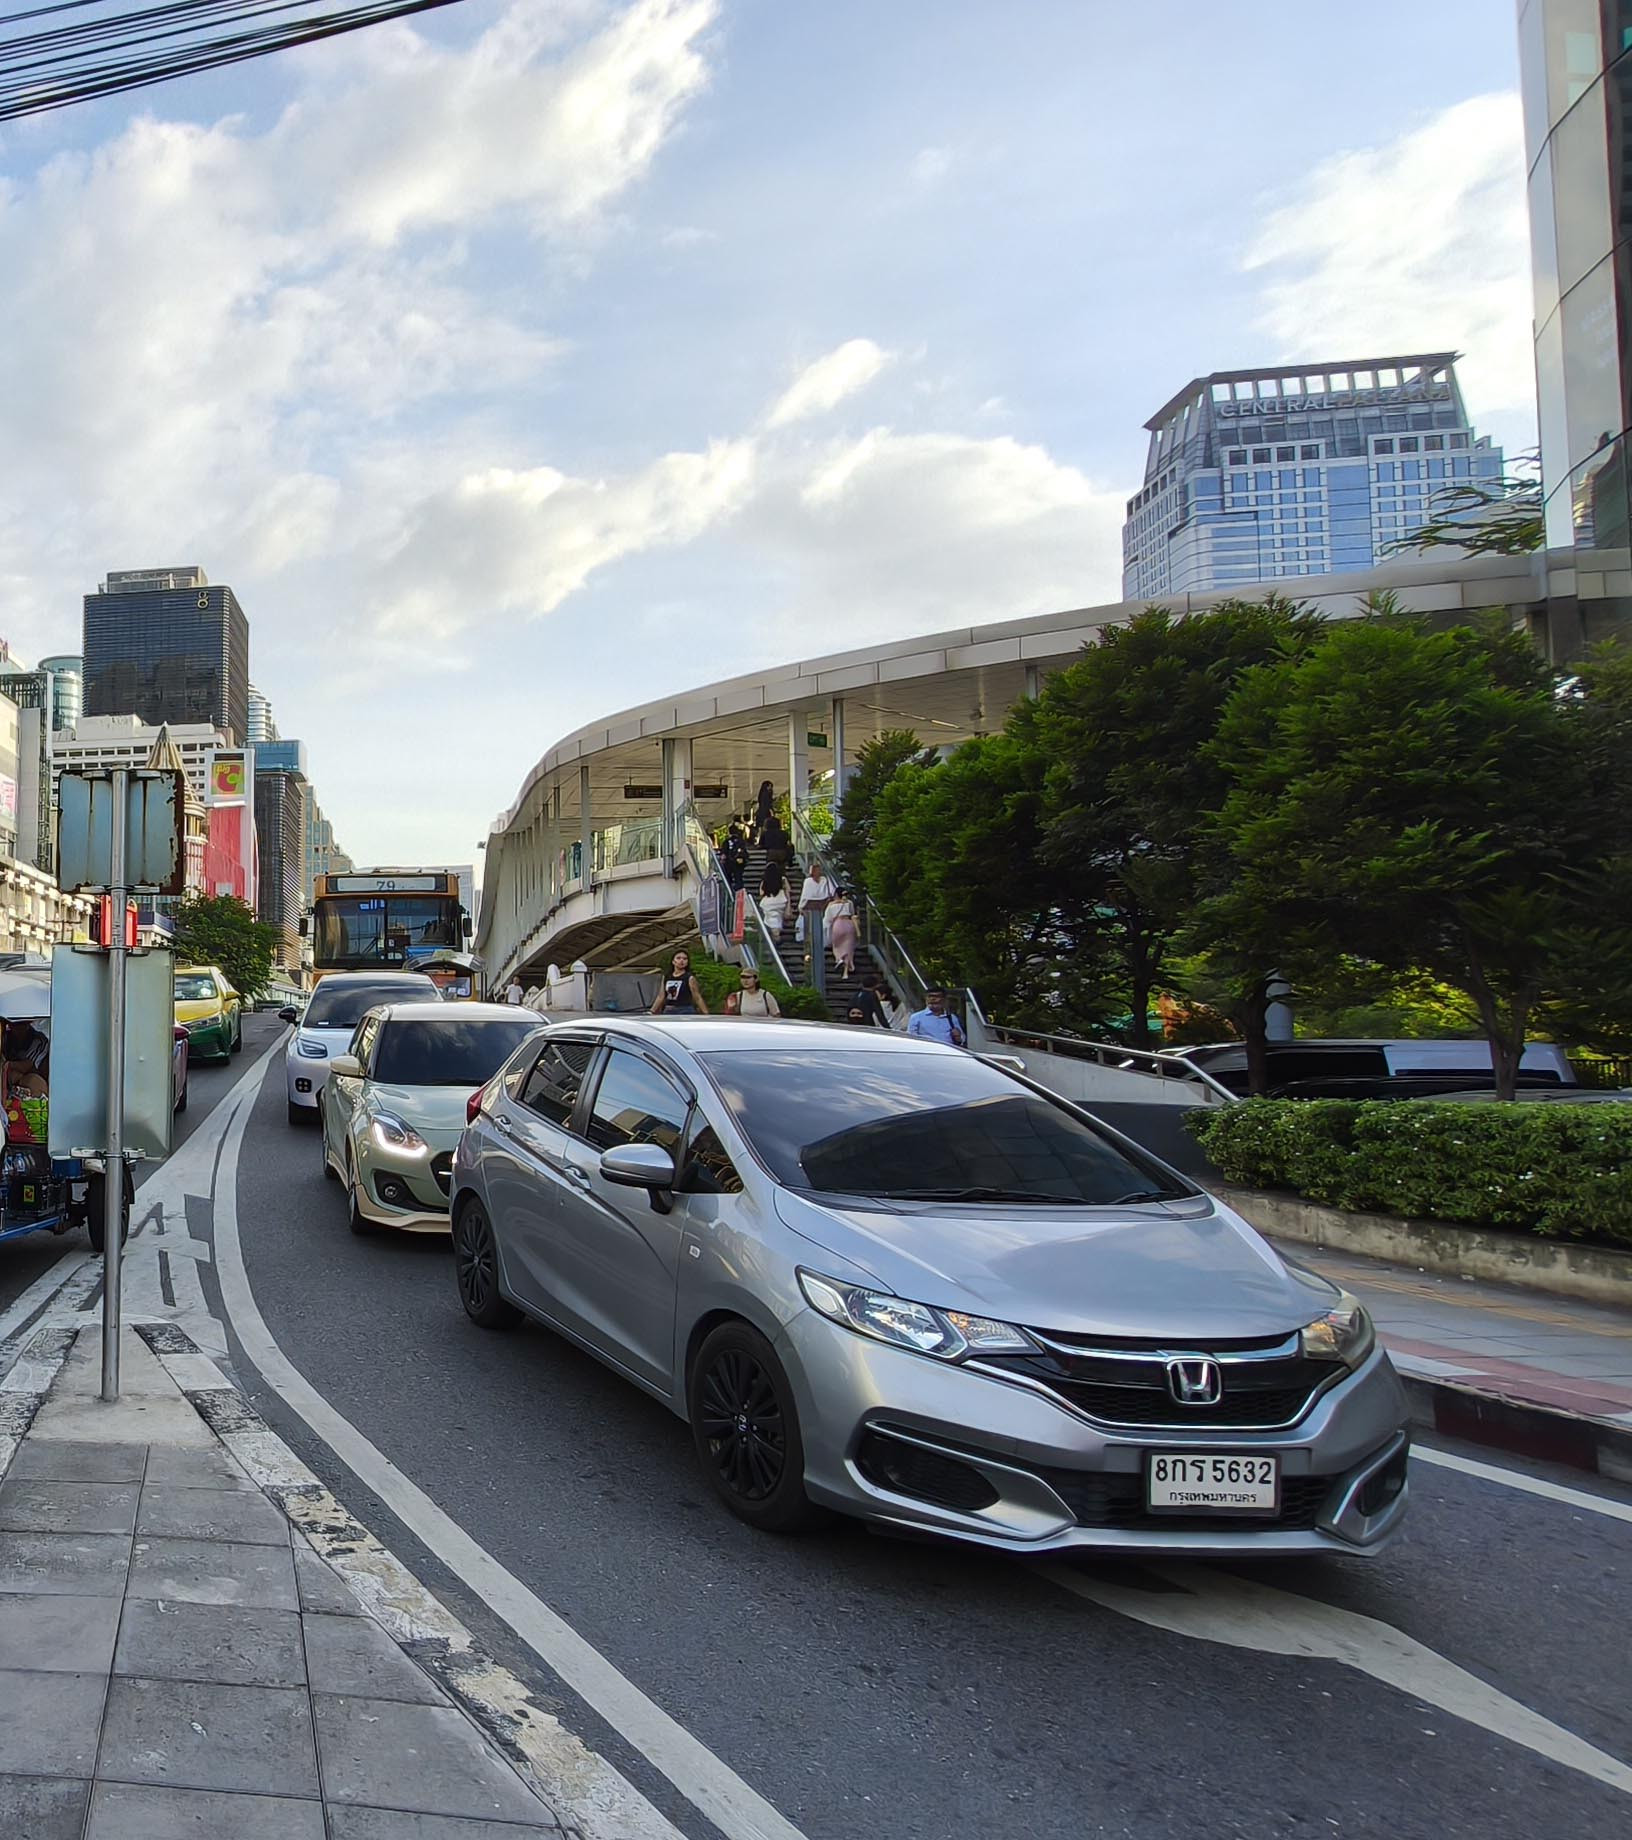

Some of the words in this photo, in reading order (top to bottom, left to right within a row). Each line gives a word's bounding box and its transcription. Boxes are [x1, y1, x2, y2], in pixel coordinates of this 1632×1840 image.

[1220, 398, 1336, 418] CENTRAL
[376, 881, 396, 891] 79
[1155, 1458, 1206, 1482] 8กร
[1211, 1459, 1272, 1485] 5632
[1169, 1491, 1257, 1504] กรุงเทพมหานคร
